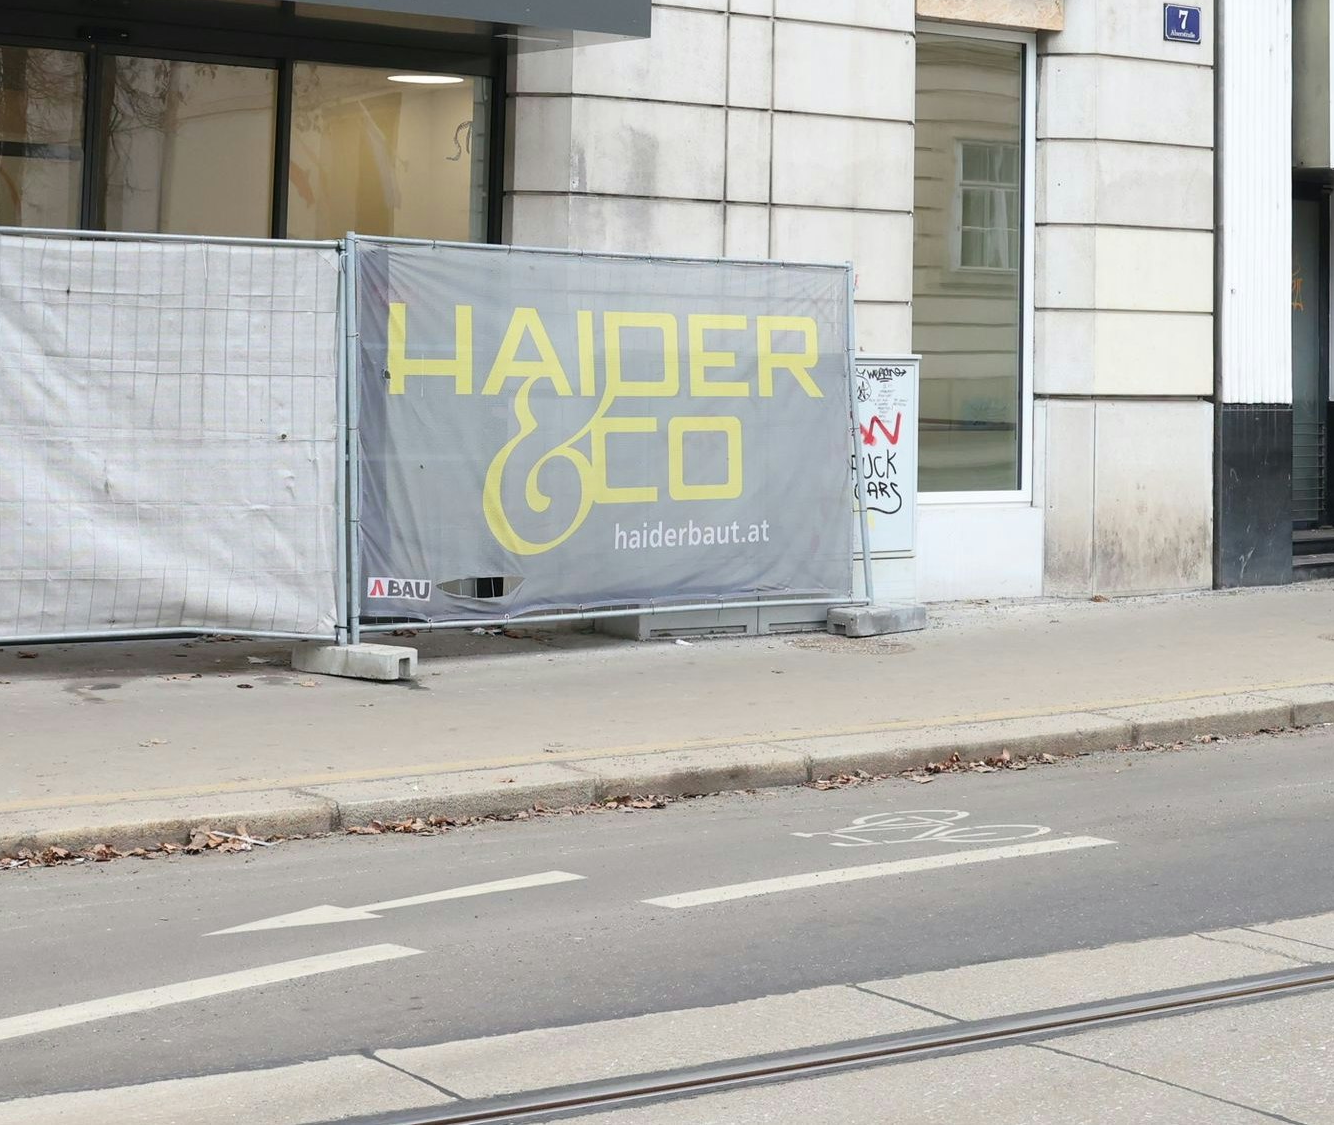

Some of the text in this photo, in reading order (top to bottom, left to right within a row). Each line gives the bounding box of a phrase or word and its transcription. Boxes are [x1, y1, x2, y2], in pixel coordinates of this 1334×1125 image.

[1178, 9, 1189, 30] 7
[387, 301, 824, 399] HAIDER
[593, 415, 742, 505] CO
[613, 518, 771, 552] haiderbaut.at
